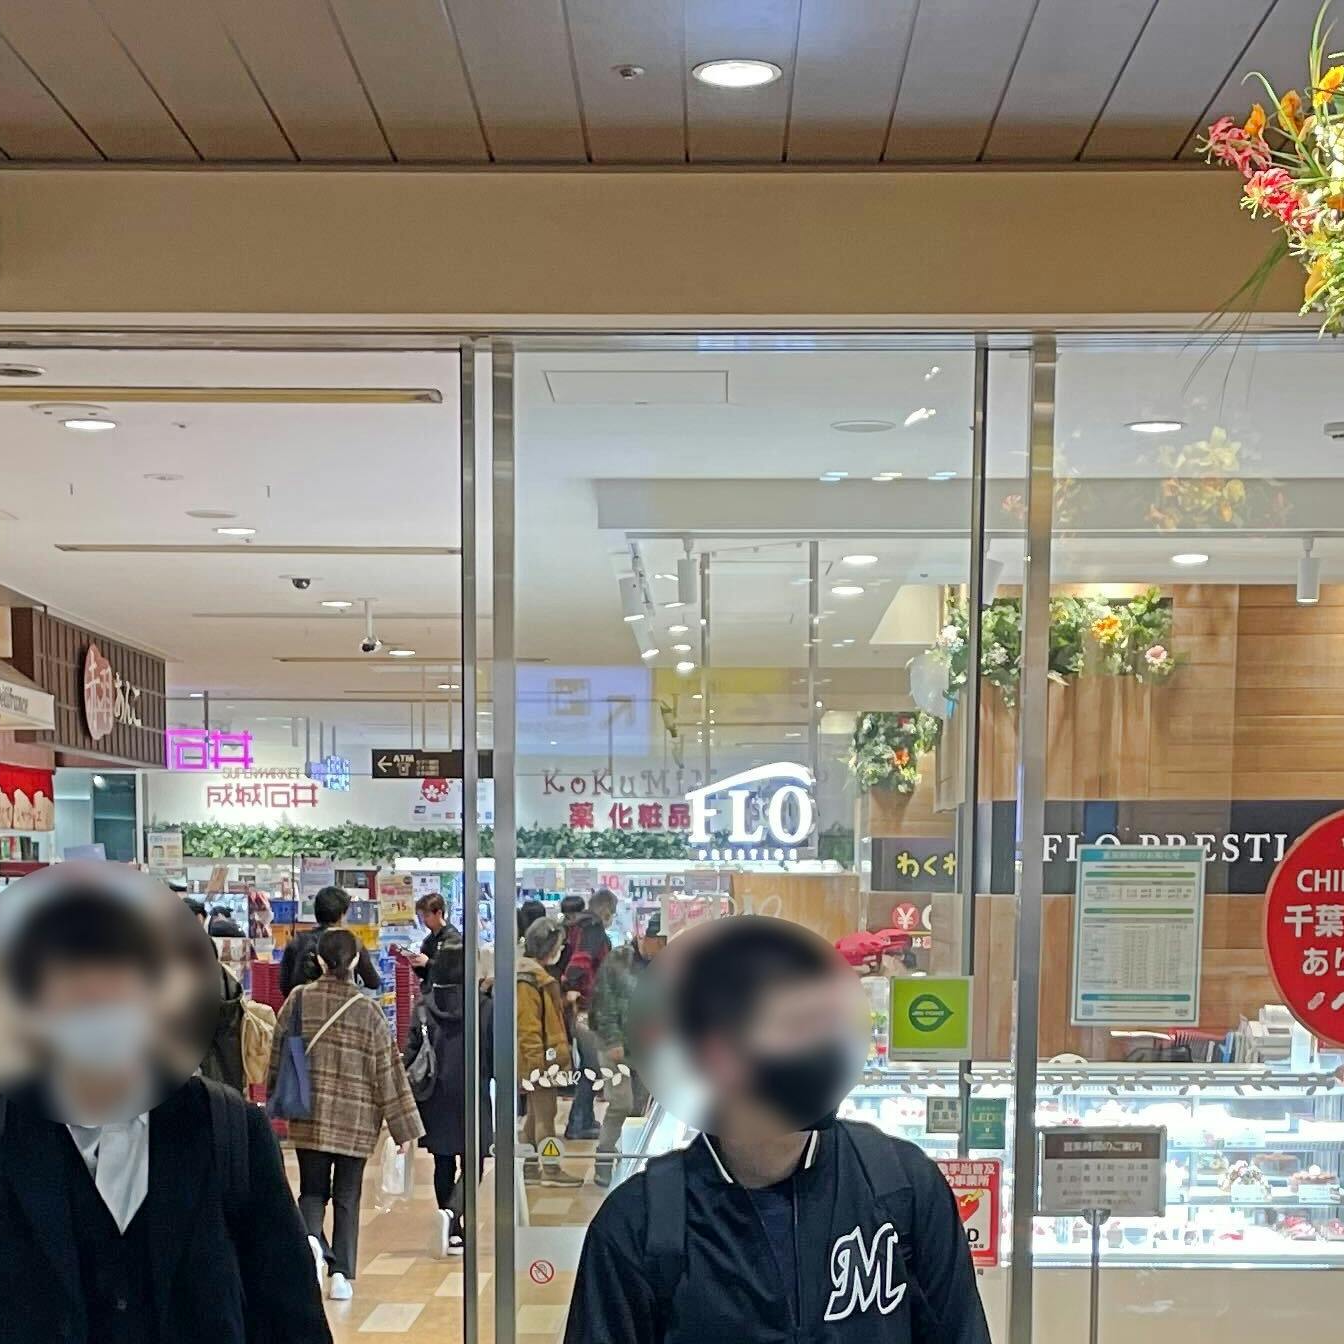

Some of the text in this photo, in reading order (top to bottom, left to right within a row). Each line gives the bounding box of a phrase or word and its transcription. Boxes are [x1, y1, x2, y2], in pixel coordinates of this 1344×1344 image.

[393, 754, 415, 763] ATM
[207, 783, 319, 808] 成城石井
[685, 768, 816, 845] FLO
[569, 802, 690, 829] 薬 化粧品
